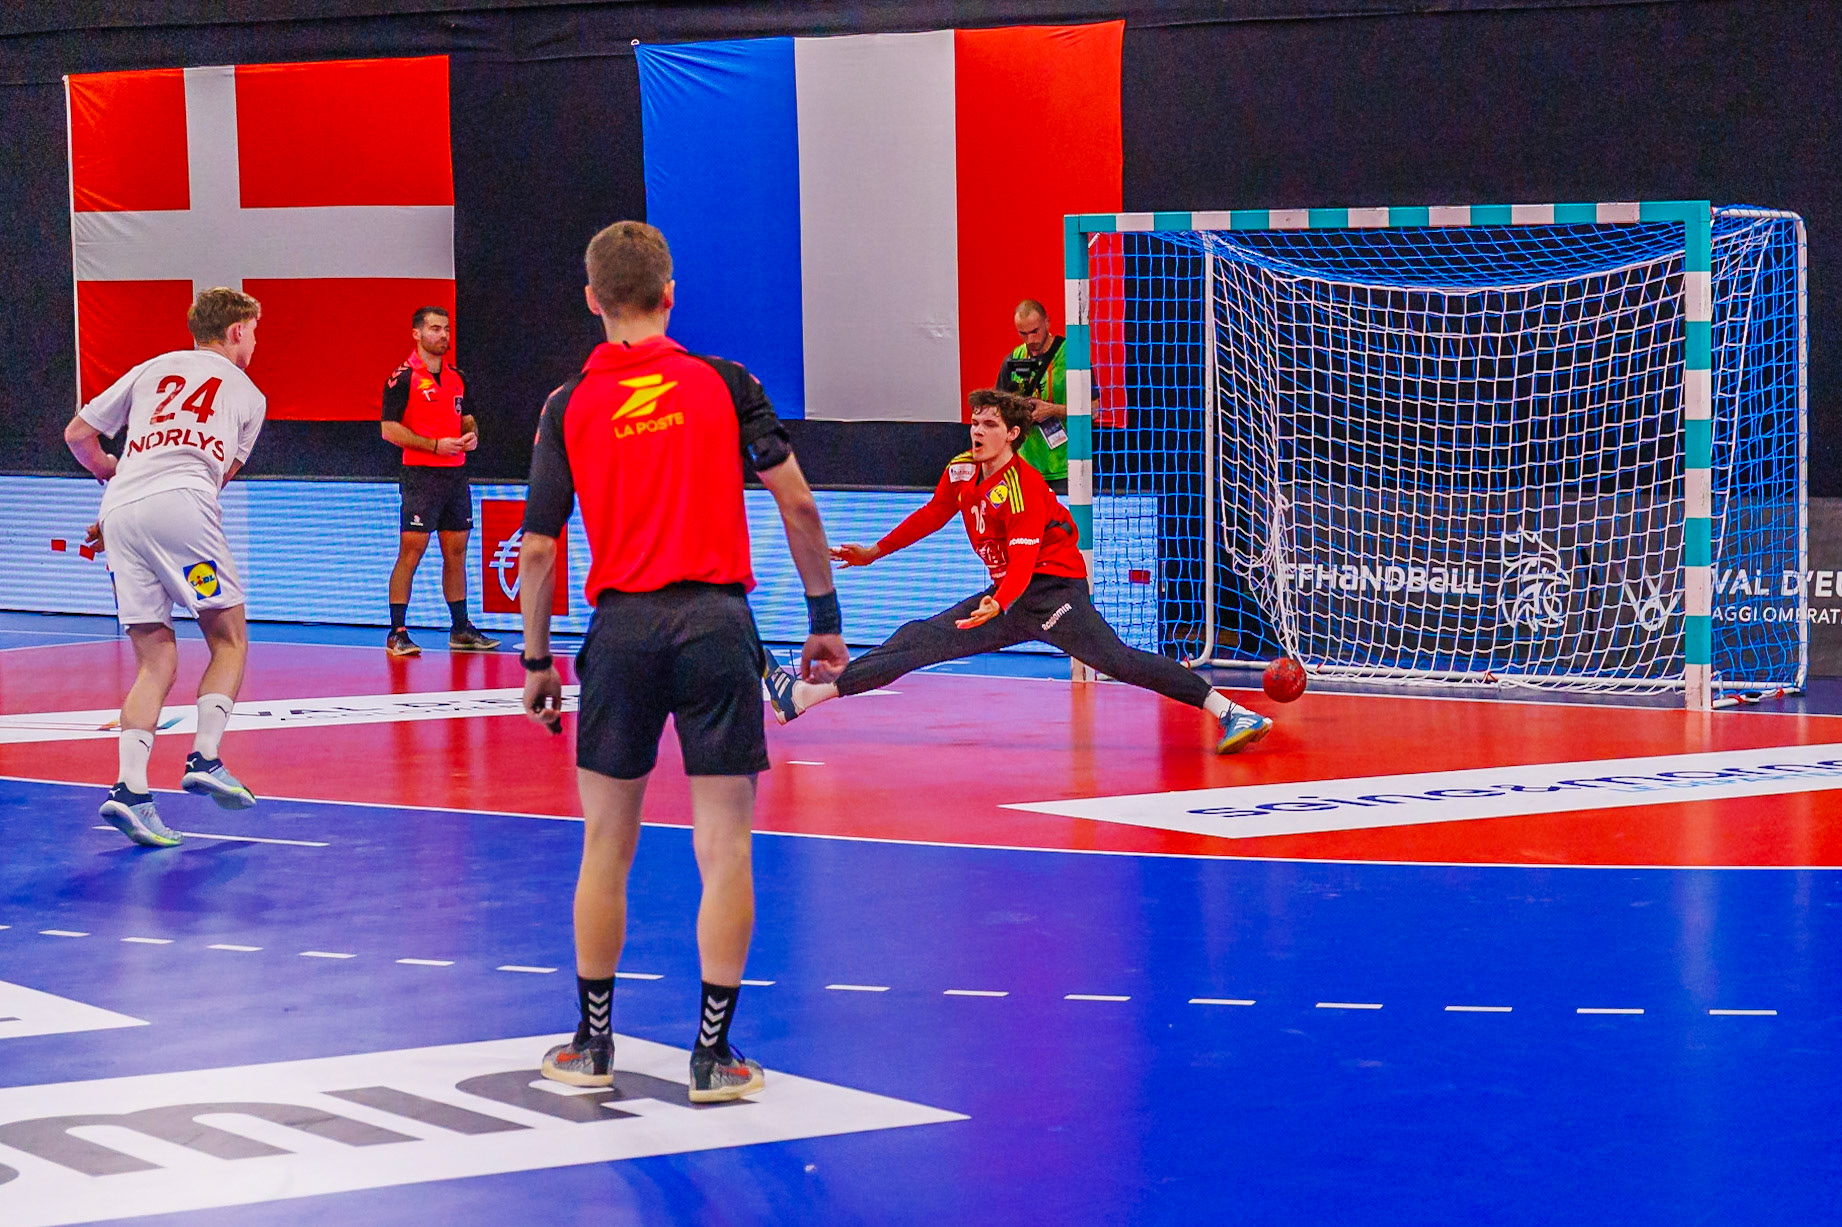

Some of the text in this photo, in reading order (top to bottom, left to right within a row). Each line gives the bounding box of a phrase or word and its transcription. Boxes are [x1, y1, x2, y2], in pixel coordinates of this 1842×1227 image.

[149, 375, 222, 425] 24
[613, 411, 684, 439] LA POSTE
[127, 428, 225, 462] NORLYS
[1711, 568, 1842, 597] VAL D'E
